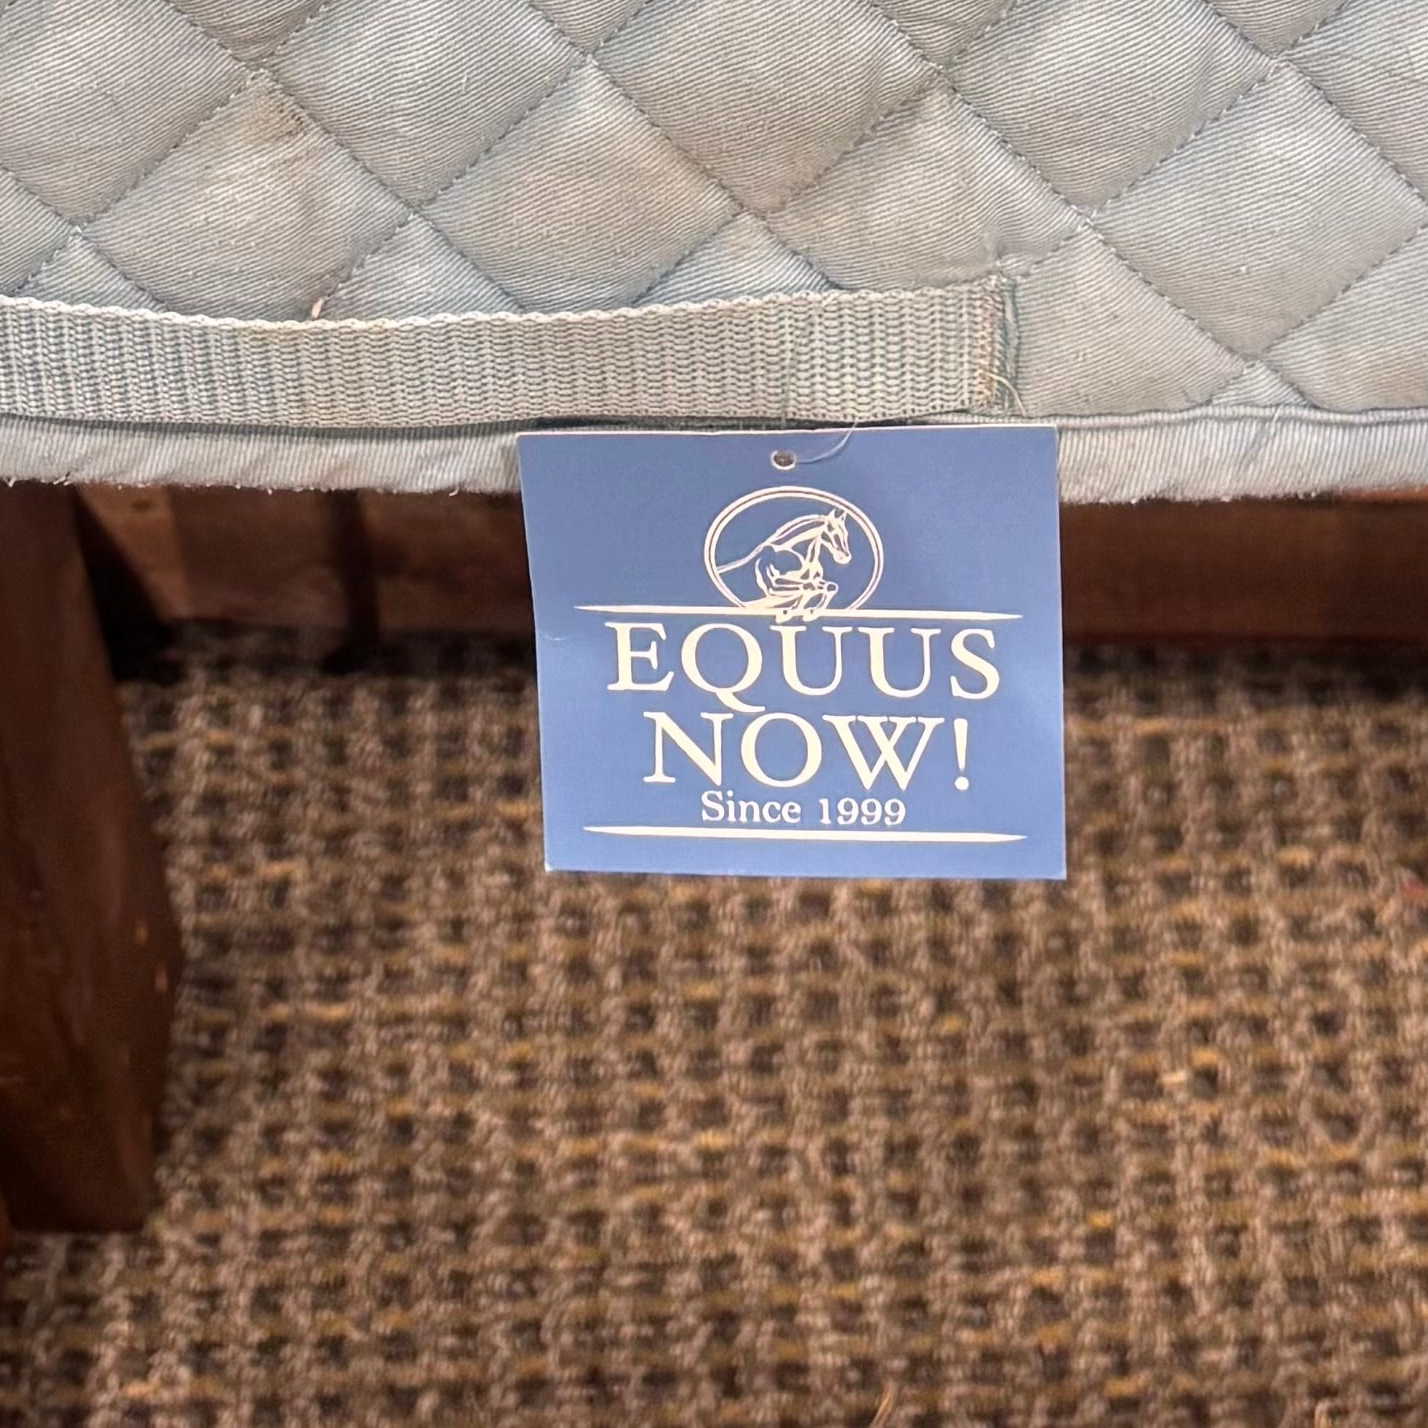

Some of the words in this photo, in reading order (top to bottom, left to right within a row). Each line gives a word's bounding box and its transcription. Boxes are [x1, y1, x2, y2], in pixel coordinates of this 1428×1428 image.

[604, 621, 1001, 713] EQUUS
[642, 711, 970, 792] NOW!
[700, 790, 803, 825] Since
[818, 797, 907, 826] 1999
